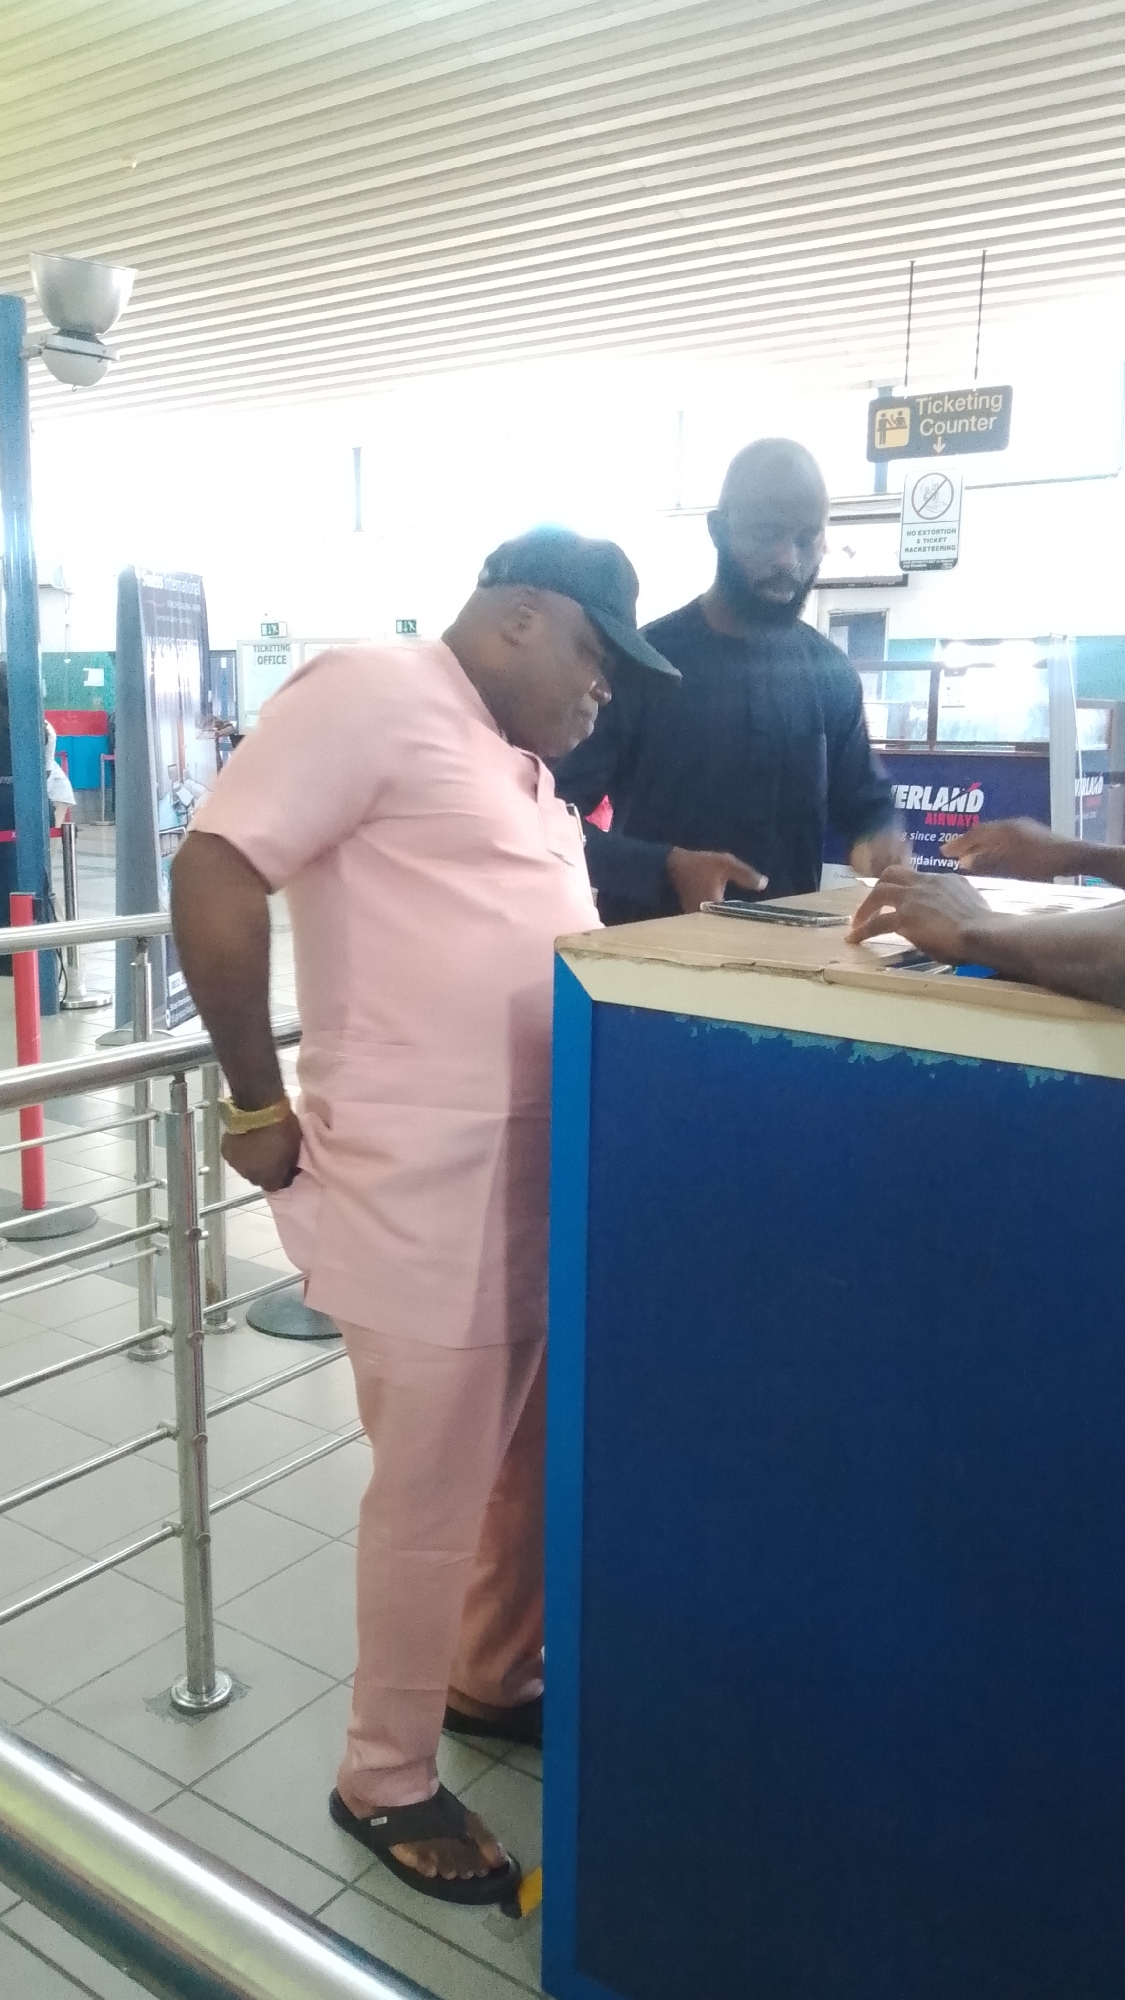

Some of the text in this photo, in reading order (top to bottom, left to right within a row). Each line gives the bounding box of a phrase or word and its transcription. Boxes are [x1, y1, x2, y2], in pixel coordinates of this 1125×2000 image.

[916, 393, 1003, 415] Ticketing
[920, 415, 997, 436] Counter
[918, 528, 956, 536] EXTORTION
[905, 545, 956, 553] RACKETEERING
[253, 644, 291, 653] TICKETING
[257, 655, 287, 665] OFFICE
[925, 812, 979, 827] AIRWAYS
[910, 831, 936, 841] since
[938, 833, 963, 842] 200
